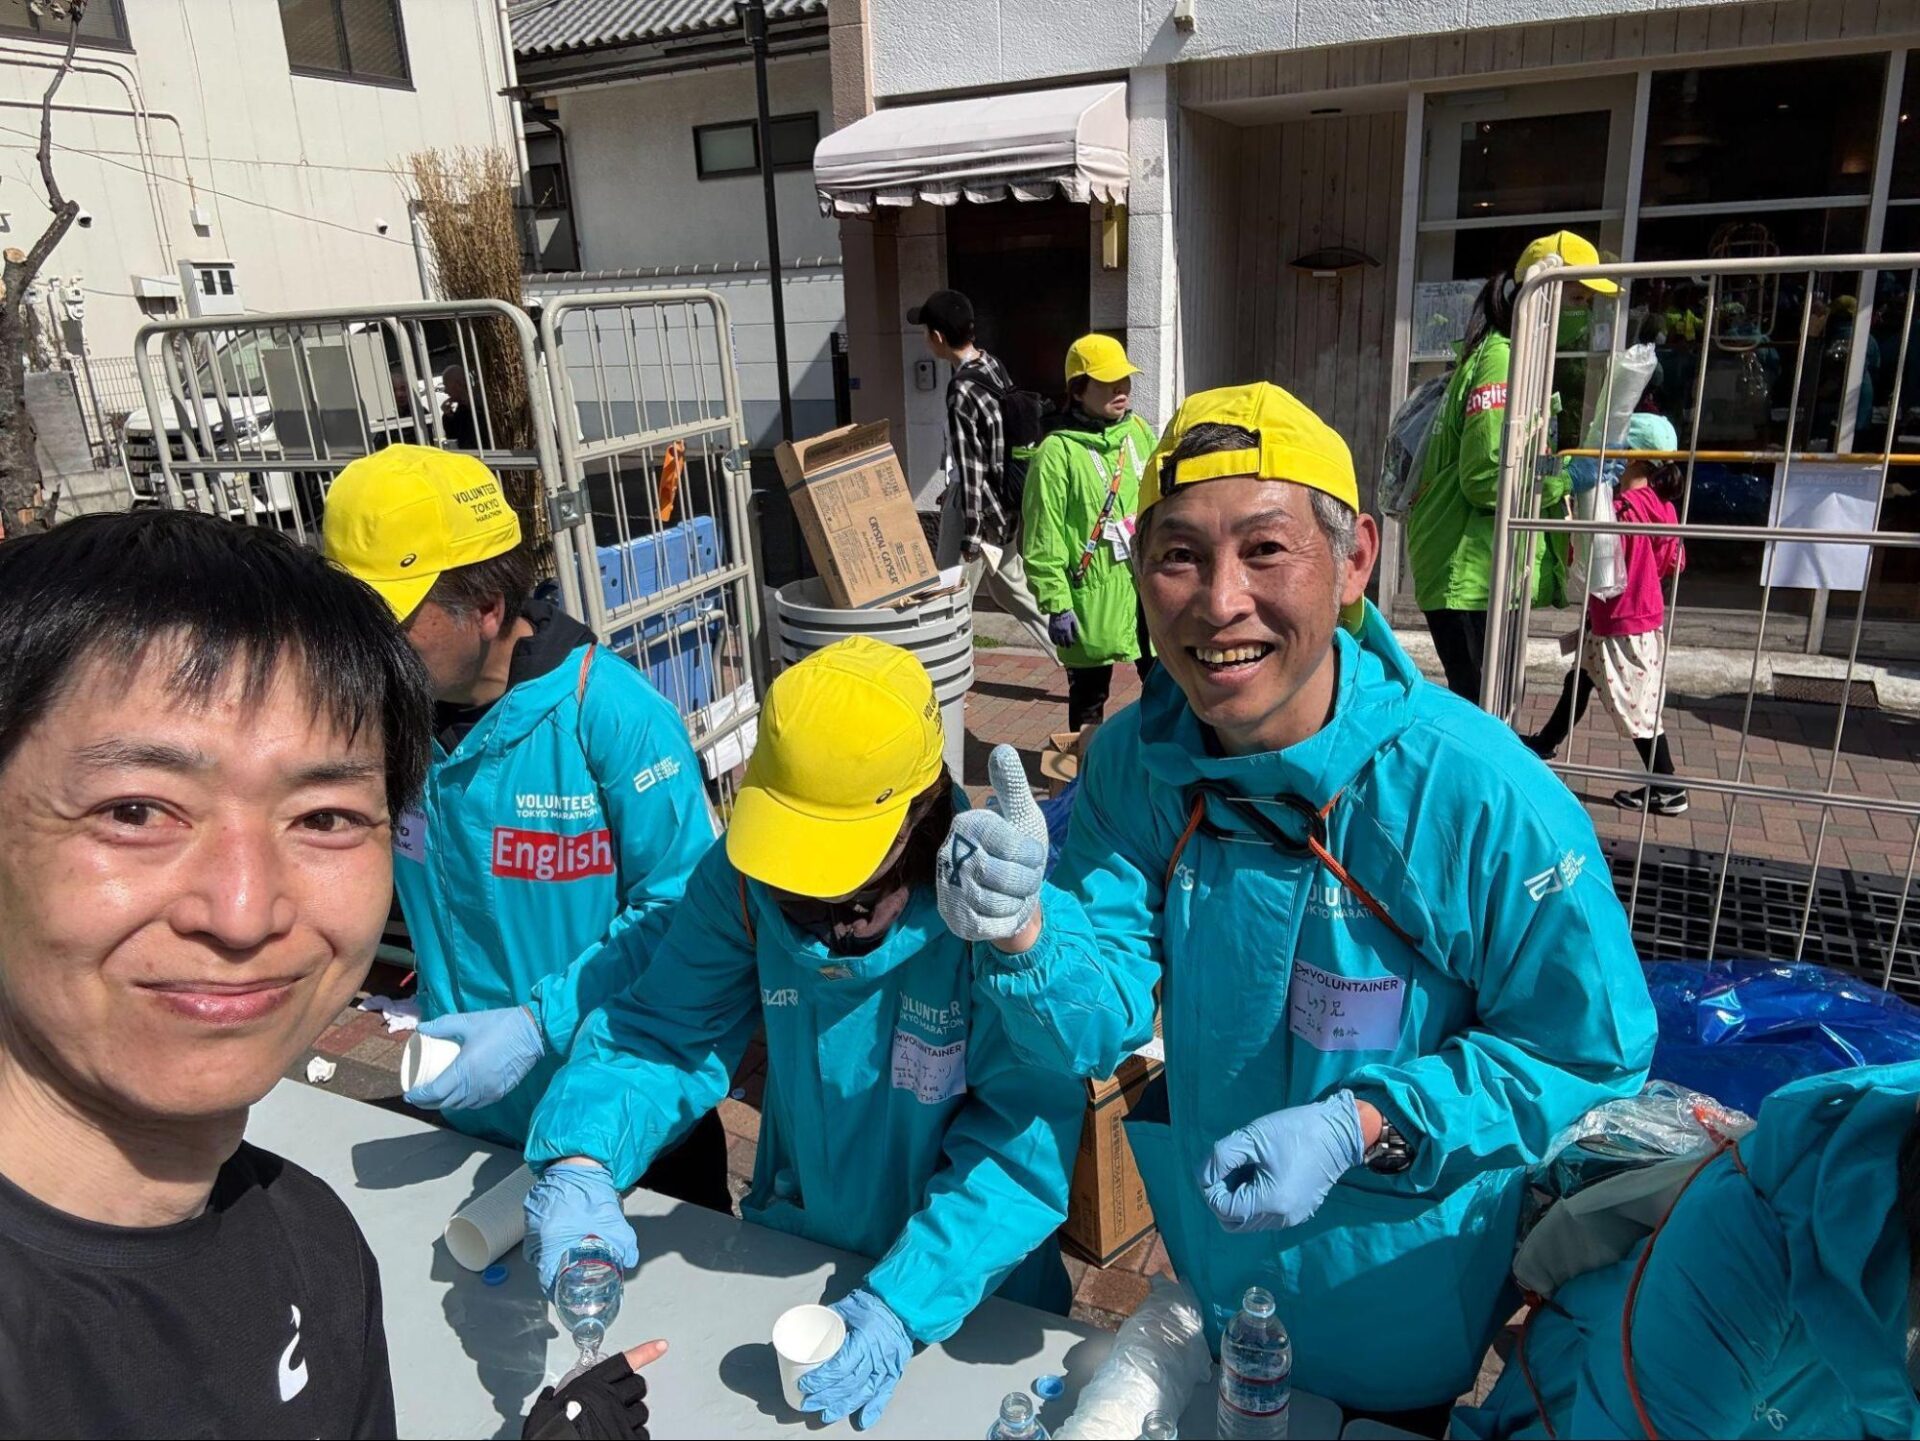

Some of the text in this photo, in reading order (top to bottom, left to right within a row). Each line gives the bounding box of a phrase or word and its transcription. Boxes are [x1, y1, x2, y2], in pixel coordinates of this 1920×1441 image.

[1466, 384, 1507, 411] Englis
[471, 498, 500, 514] TOKYO
[868, 516, 887, 550] CRYSTAL
[881, 551, 900, 585] GEYSER
[515, 793, 596, 811] VOLUNTEER
[516, 807, 598, 820] TOKYO MARATHON
[496, 831, 612, 881] English
[1307, 970, 1399, 993] VOLUNTAINER
